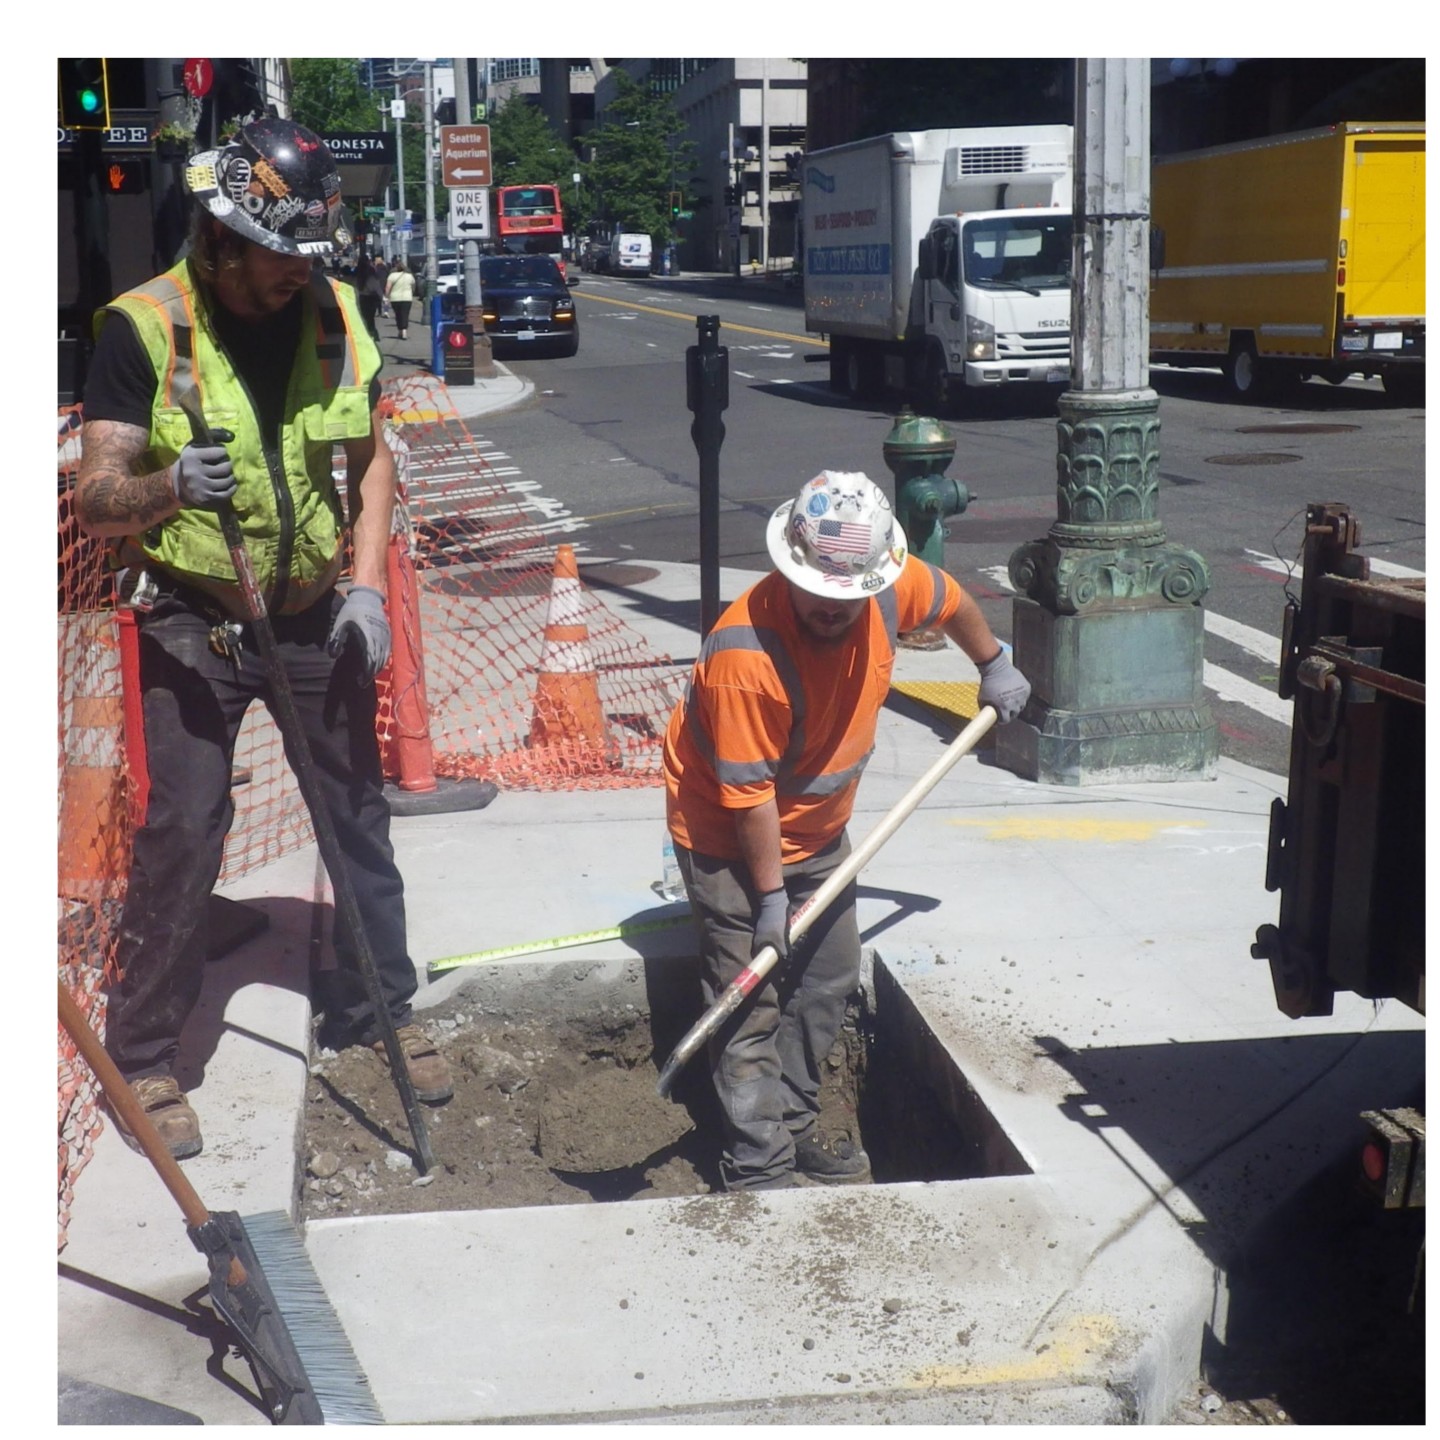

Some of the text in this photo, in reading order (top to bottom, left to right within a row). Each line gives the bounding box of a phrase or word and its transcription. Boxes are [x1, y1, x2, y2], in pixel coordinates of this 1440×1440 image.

[449, 133, 482, 143] Seattle
[323, 139, 385, 149] SONESTA
[445, 149, 488, 160] Aquarium
[456, 193, 482, 203] ONE
[455, 206, 483, 217] WAY
